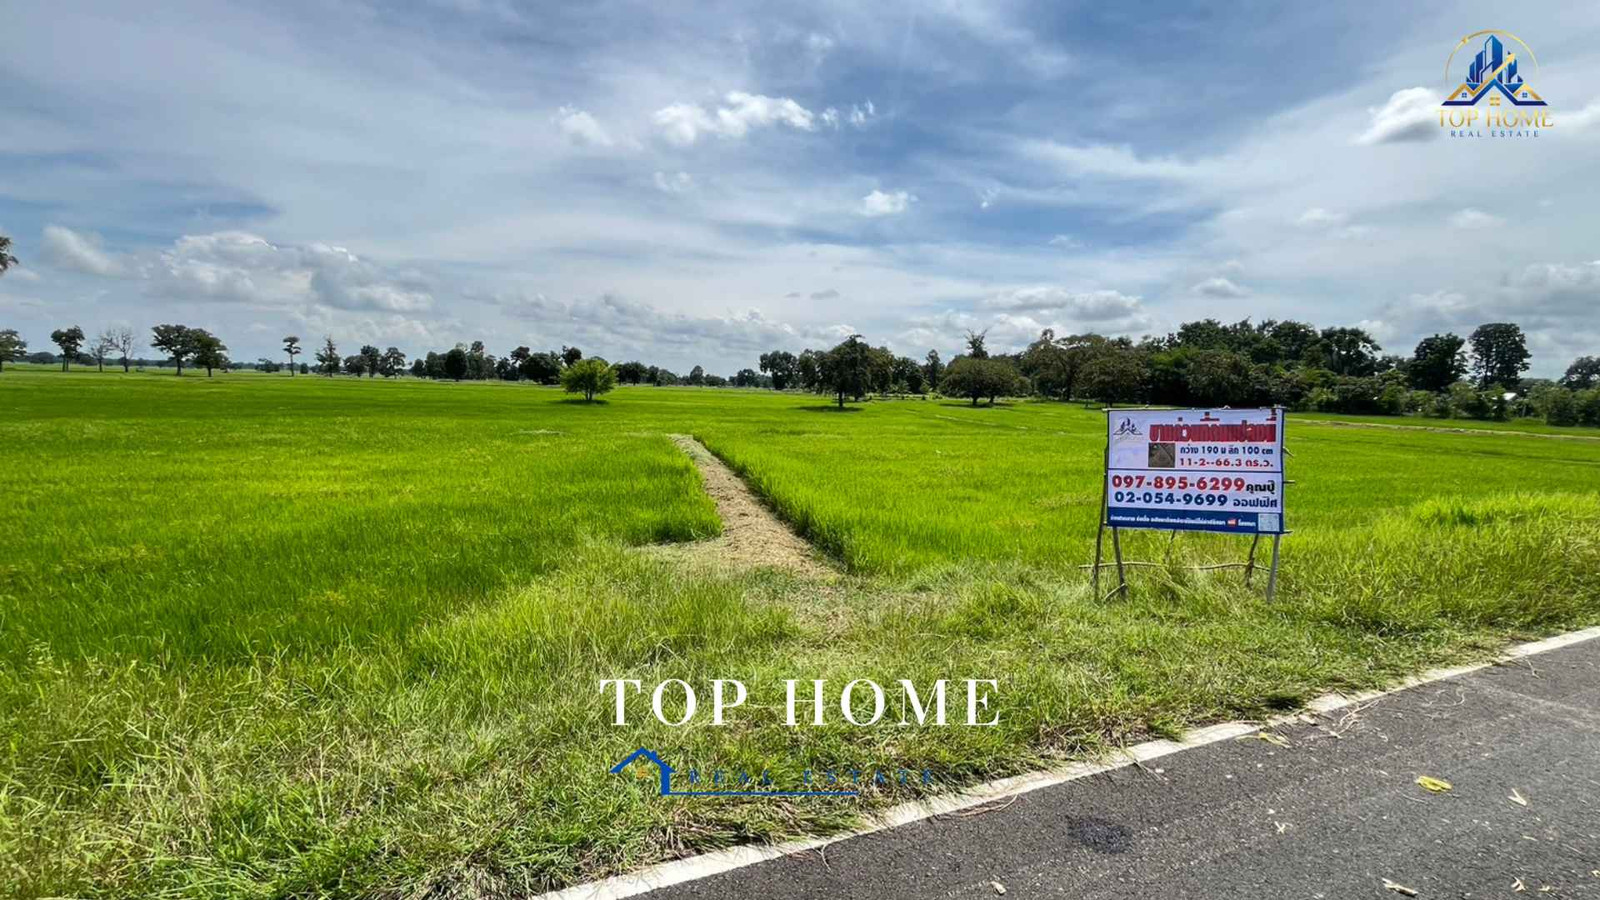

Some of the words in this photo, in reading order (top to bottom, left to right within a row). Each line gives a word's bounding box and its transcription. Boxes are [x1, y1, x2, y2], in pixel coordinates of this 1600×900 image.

[1201, 446, 1219, 455] 190
[1242, 446, 1260, 455] 100
[1112, 475, 1245, 492] 097-895-6299
[1114, 491, 1228, 507] 02-054-9699
